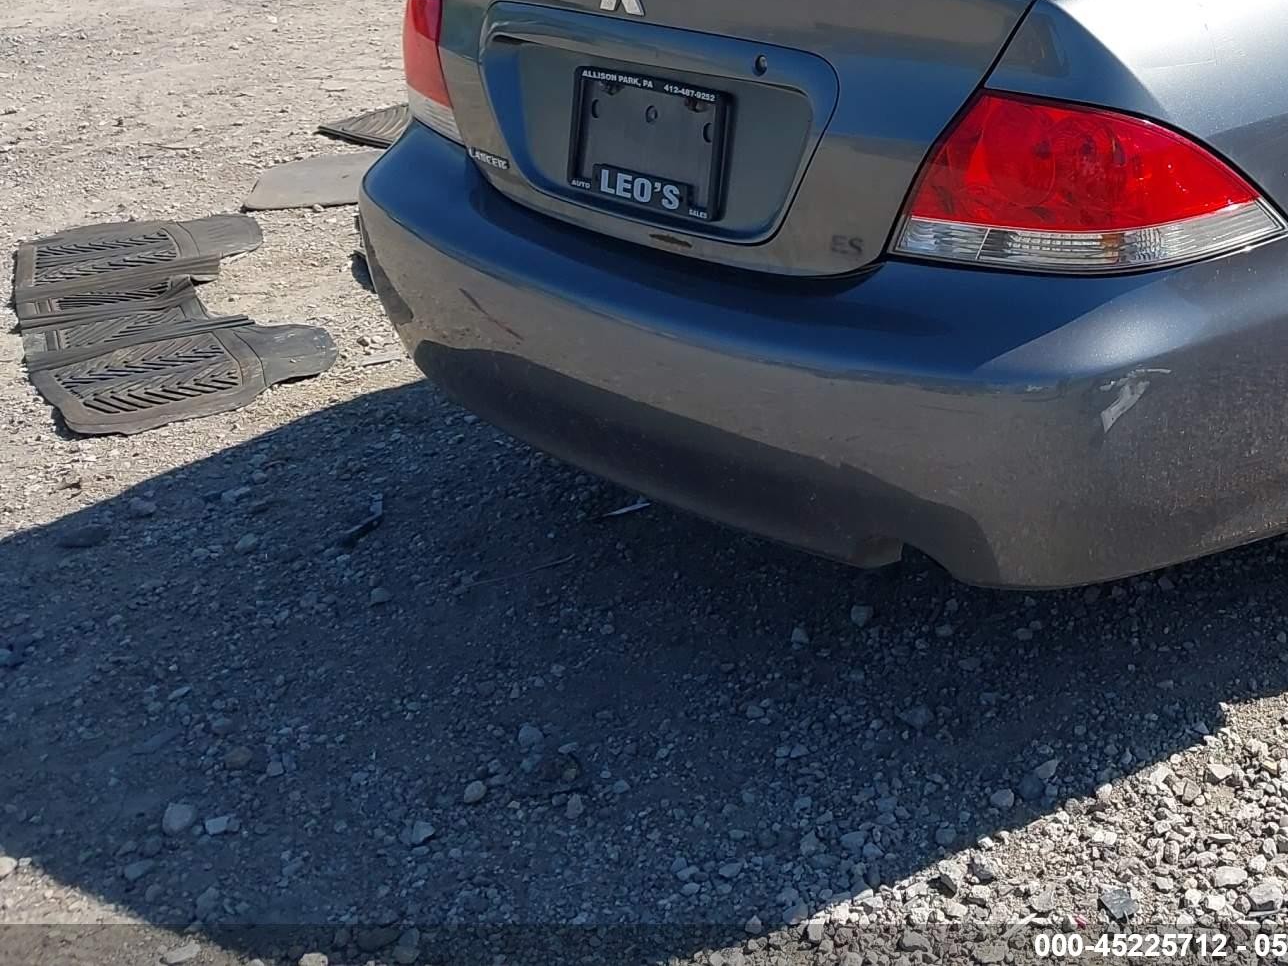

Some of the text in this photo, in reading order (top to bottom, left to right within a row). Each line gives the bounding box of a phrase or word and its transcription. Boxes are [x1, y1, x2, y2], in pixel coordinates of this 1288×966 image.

[581, 69, 617, 82] ALLISON
[618, 75, 642, 88] PARK,
[642, 79, 654, 89] PA
[570, 169, 708, 219] AUTO LEO'S SALES
[831, 234, 864, 254] ES
